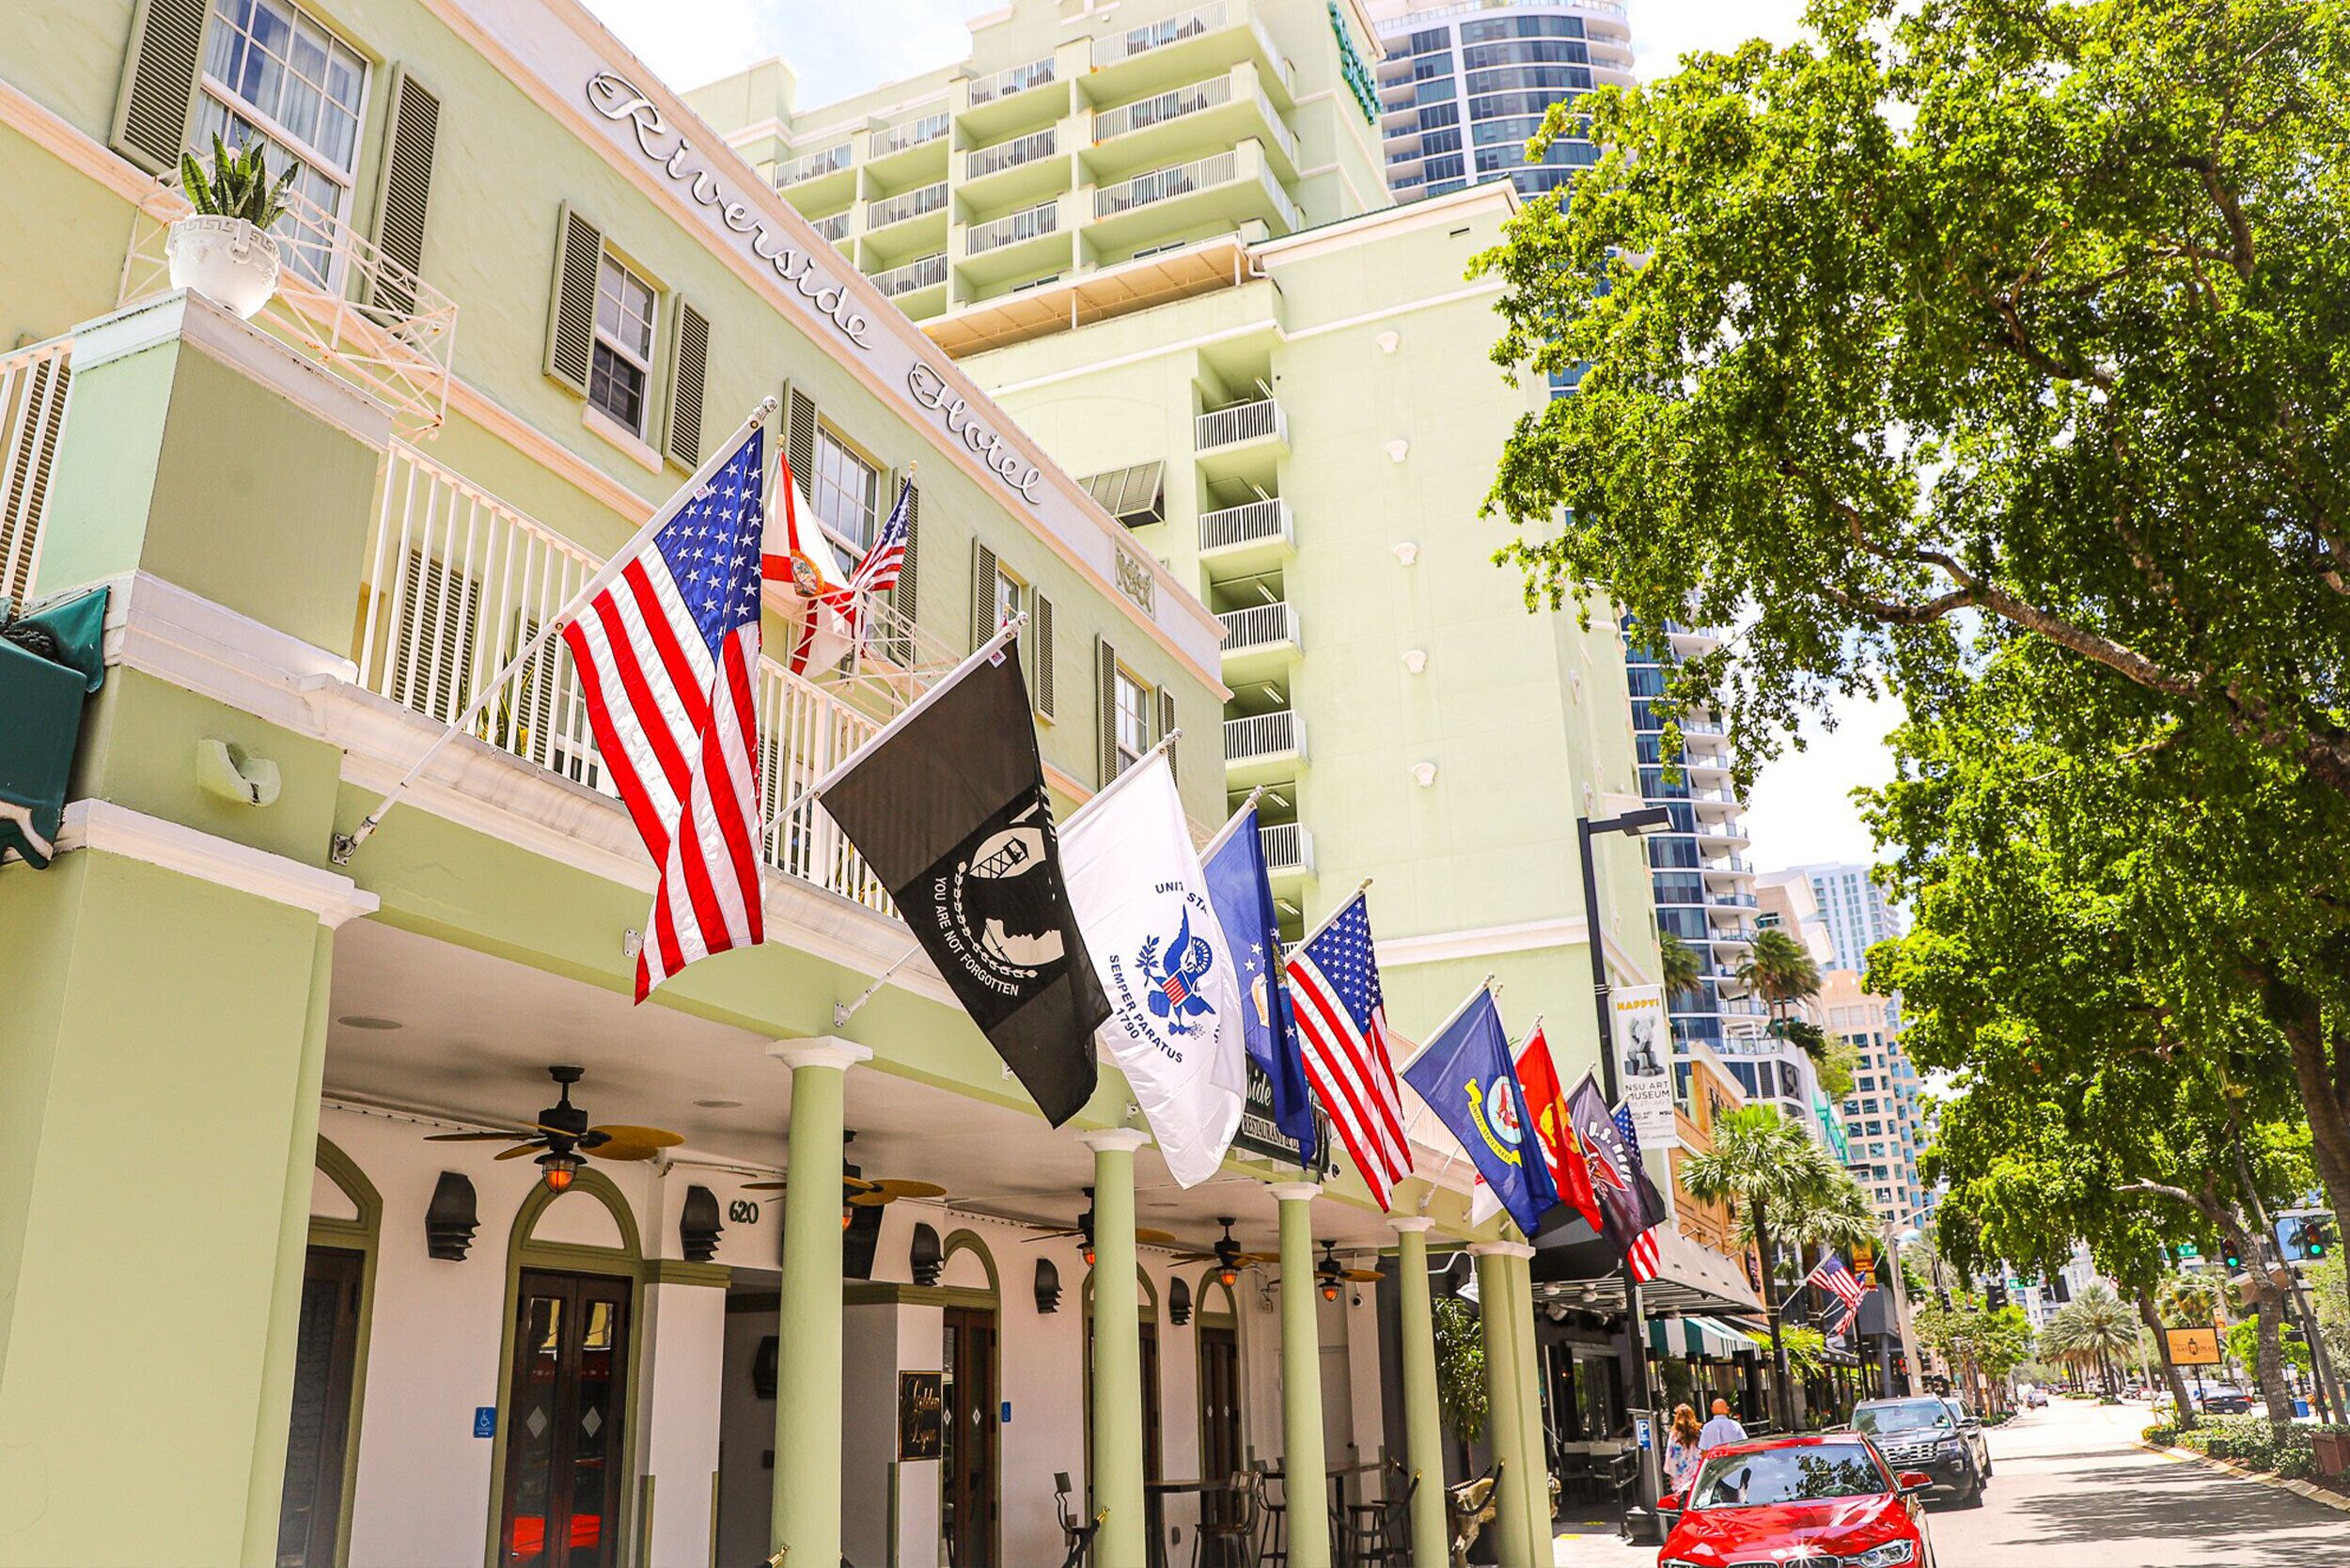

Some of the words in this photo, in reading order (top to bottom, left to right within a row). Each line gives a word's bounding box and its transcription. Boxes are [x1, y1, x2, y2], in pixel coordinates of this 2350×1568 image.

[586, 70, 871, 351] Riverside
[907, 360, 1042, 505] Hotel
[934, 877, 948, 901] YOU
[935, 905, 951, 929] ARE
[944, 930, 964, 954] NOT
[960, 952, 1019, 996] FORGOTTEN
[1109, 954, 1136, 1011] SEMPER
[1134, 1013, 1183, 1063] PARATUS
[1617, 998, 1659, 1011] HAPPY!
[1116, 1008, 1139, 1039] 1790
[1625, 1083, 1645, 1091] NSU
[1589, 1121, 1611, 1144] U.S.
[728, 1200, 759, 1224] 620
